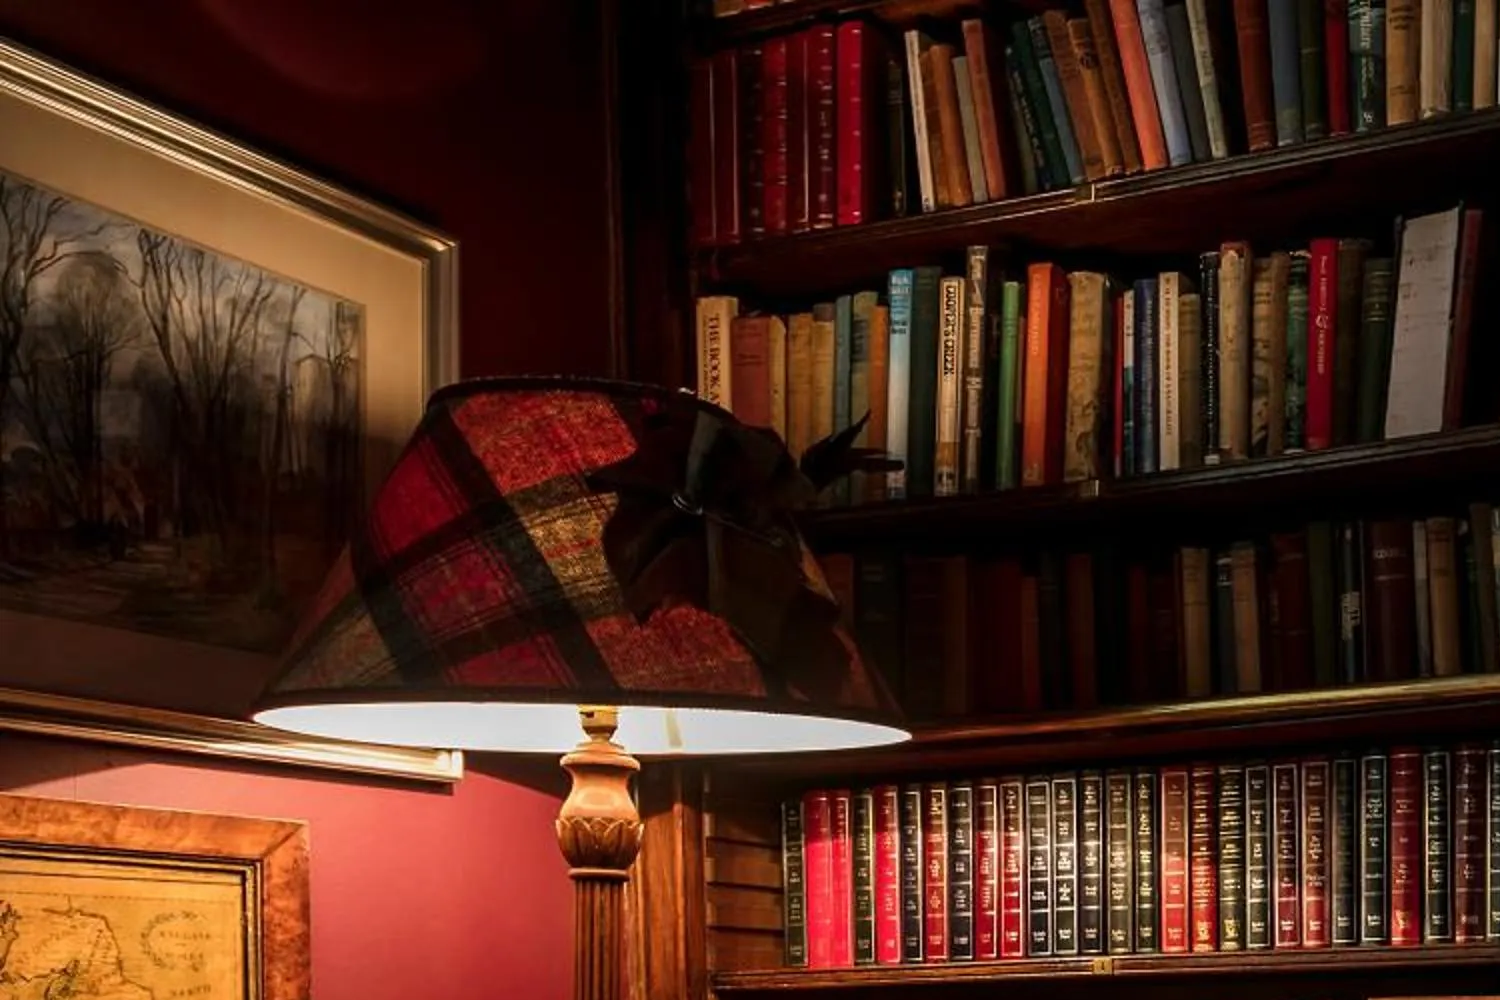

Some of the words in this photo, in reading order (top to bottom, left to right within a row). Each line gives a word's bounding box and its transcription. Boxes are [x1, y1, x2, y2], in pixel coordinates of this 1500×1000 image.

[943, 284, 958, 336] COOPER'S
[709, 314, 721, 346] THE
[710, 347, 721, 387] BOOK
[942, 339, 957, 376] CREEK
